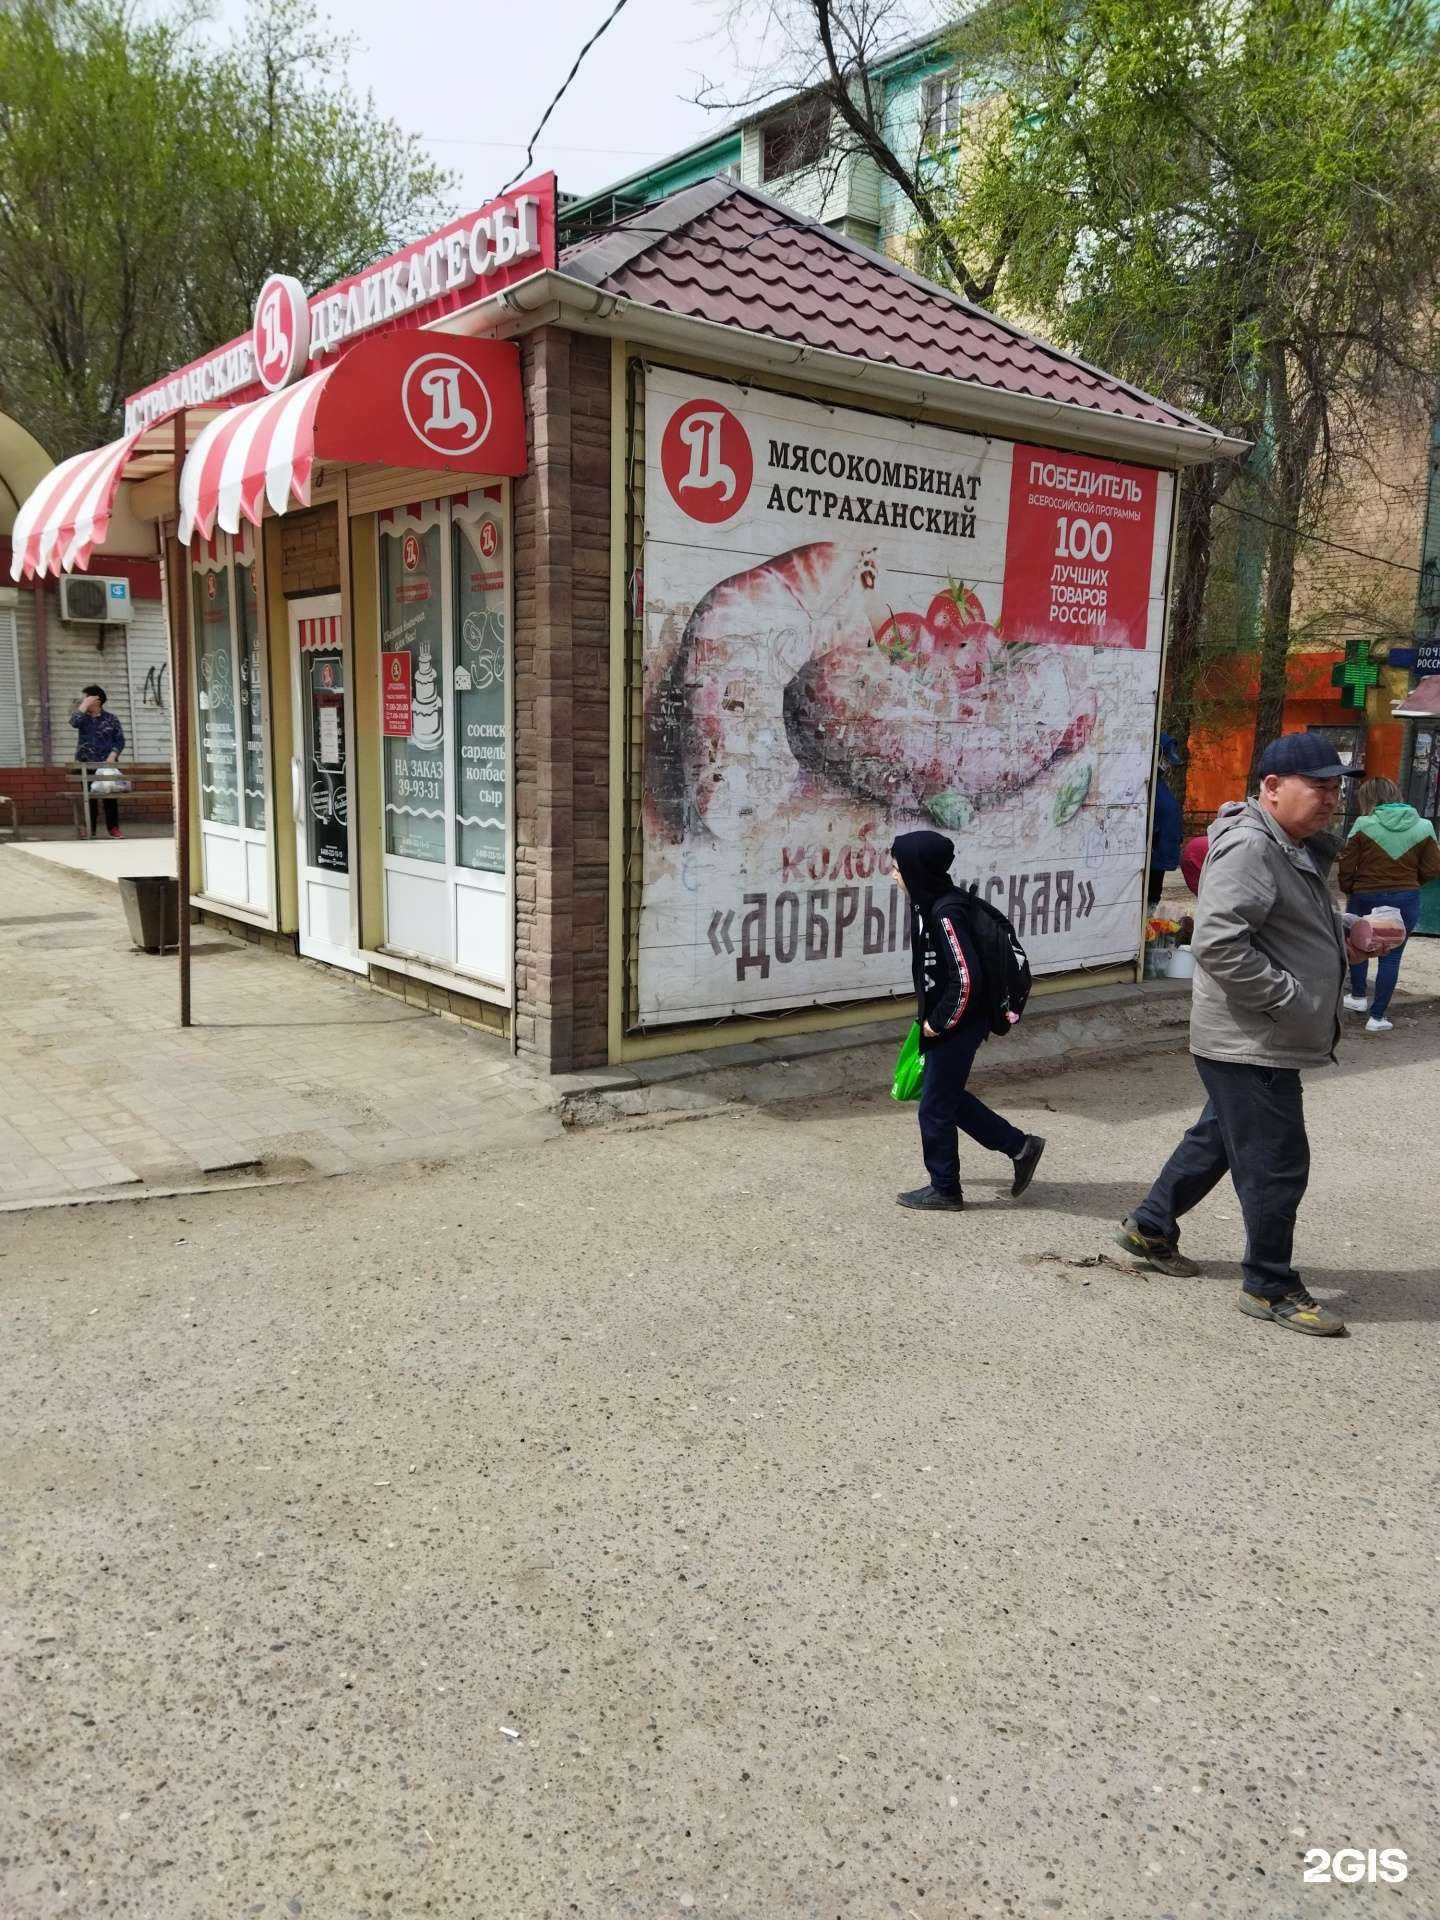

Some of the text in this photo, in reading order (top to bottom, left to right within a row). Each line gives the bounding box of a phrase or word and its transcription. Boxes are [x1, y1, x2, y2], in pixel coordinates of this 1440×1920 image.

[309, 195, 540, 359] ДЕЛИКАТЕСЫ
[767, 439, 982, 501] МЯСОКОМБИНАТ
[1028, 461, 1142, 502] ПОБЕДИТЕЛЬ
[766, 483, 977, 539] АСТРАХАНСКИЙ
[1028, 493, 1141, 521] ВСЕРОССИЙСКОЙ ПРОГРАММЫ
[1054, 516, 1113, 562] 100
[1050, 564, 1109, 587] ЛУЧШИХ
[1050, 585, 1108, 606] ТОВАРОВ
[1049, 606, 1107, 626] РОССИИ
[1418, 647, 1440, 657] ПОЧ
[394, 759, 443, 779] НА ЗАКАЗ
[398, 778, 439, 800] 39-93-31
[479, 790, 503, 807] сыр
